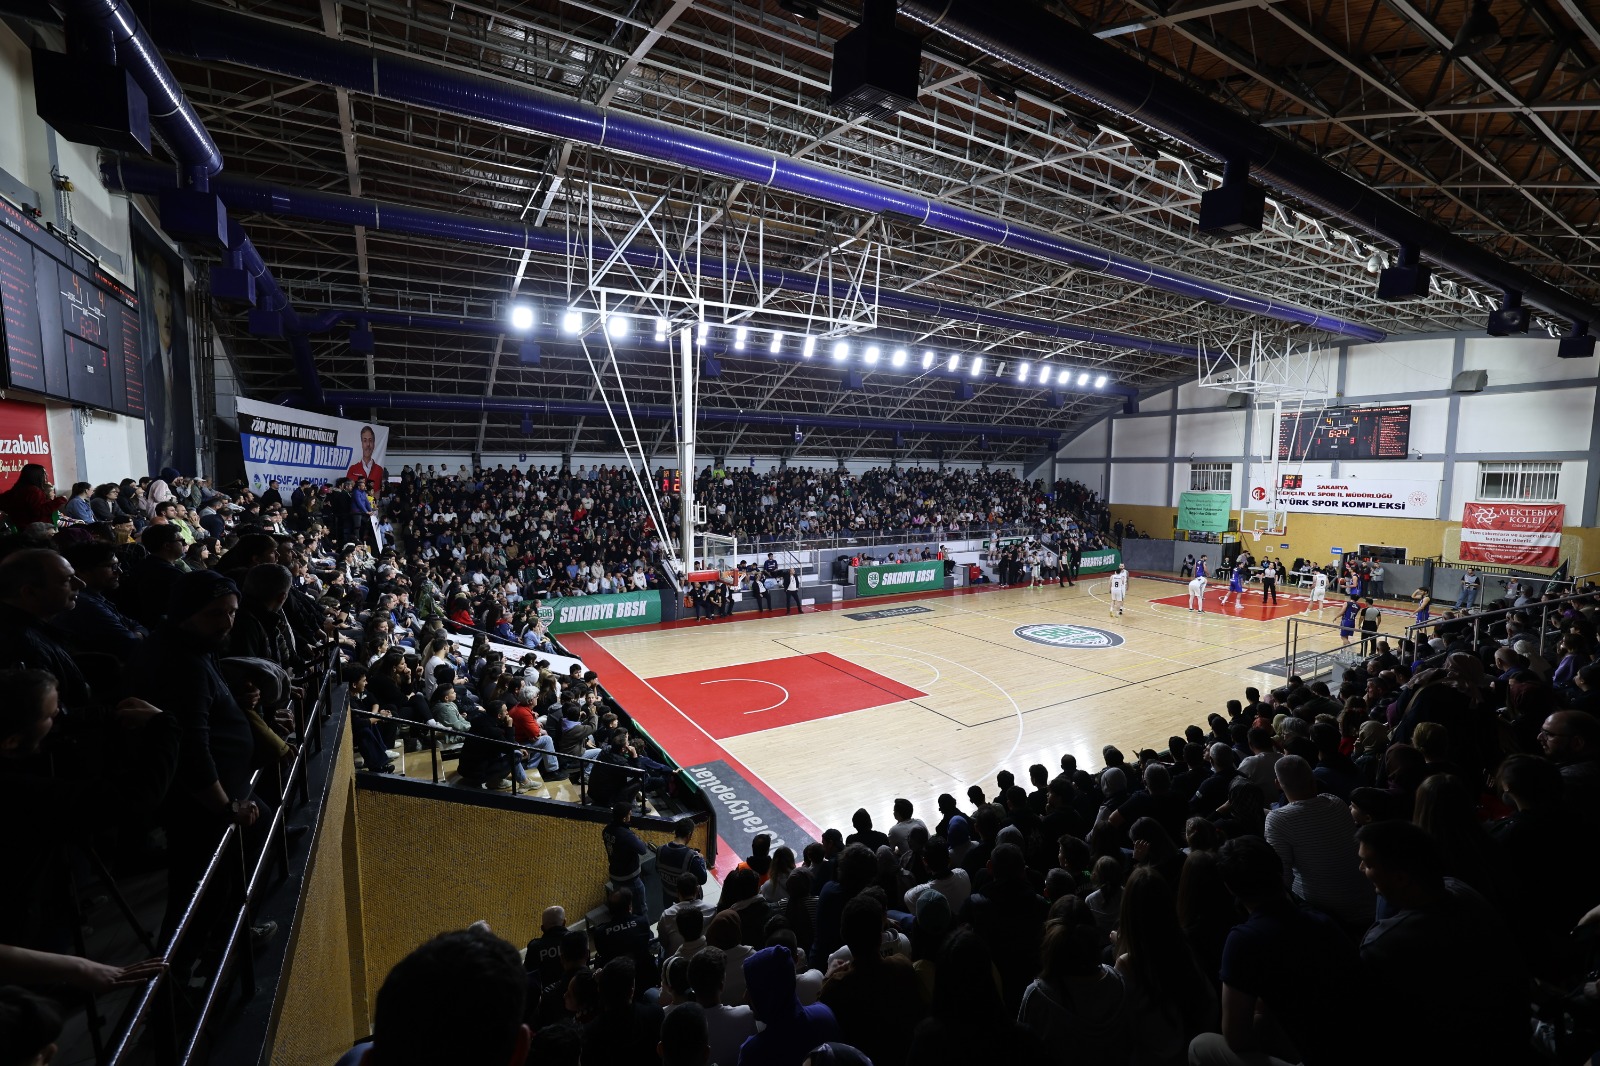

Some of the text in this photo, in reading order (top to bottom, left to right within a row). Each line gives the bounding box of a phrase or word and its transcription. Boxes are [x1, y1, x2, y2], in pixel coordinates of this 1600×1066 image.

[1352, 416, 1359, 424] 4
[266, 422, 291, 437] SPORCU
[291, 426, 298, 438] VE
[1328, 429, 1348, 438] 6:24
[1350, 437, 1355, 445] 3
[249, 436, 351, 468] BAŞARILAR DİLERİM
[263, 474, 292, 485] YUSUF
[1342, 501, 1405, 510] KOMPLEKSİ
[1499, 507, 1558, 516] MEKTEBİM
[881, 571, 917, 585] SAKARYA
[916, 569, 936, 583] BBSK
[1320, 579, 1325, 587] 9
[559, 603, 614, 623] SAKARYA
[615, 600, 648, 618] BBSK
[540, 945, 561, 961] POL
